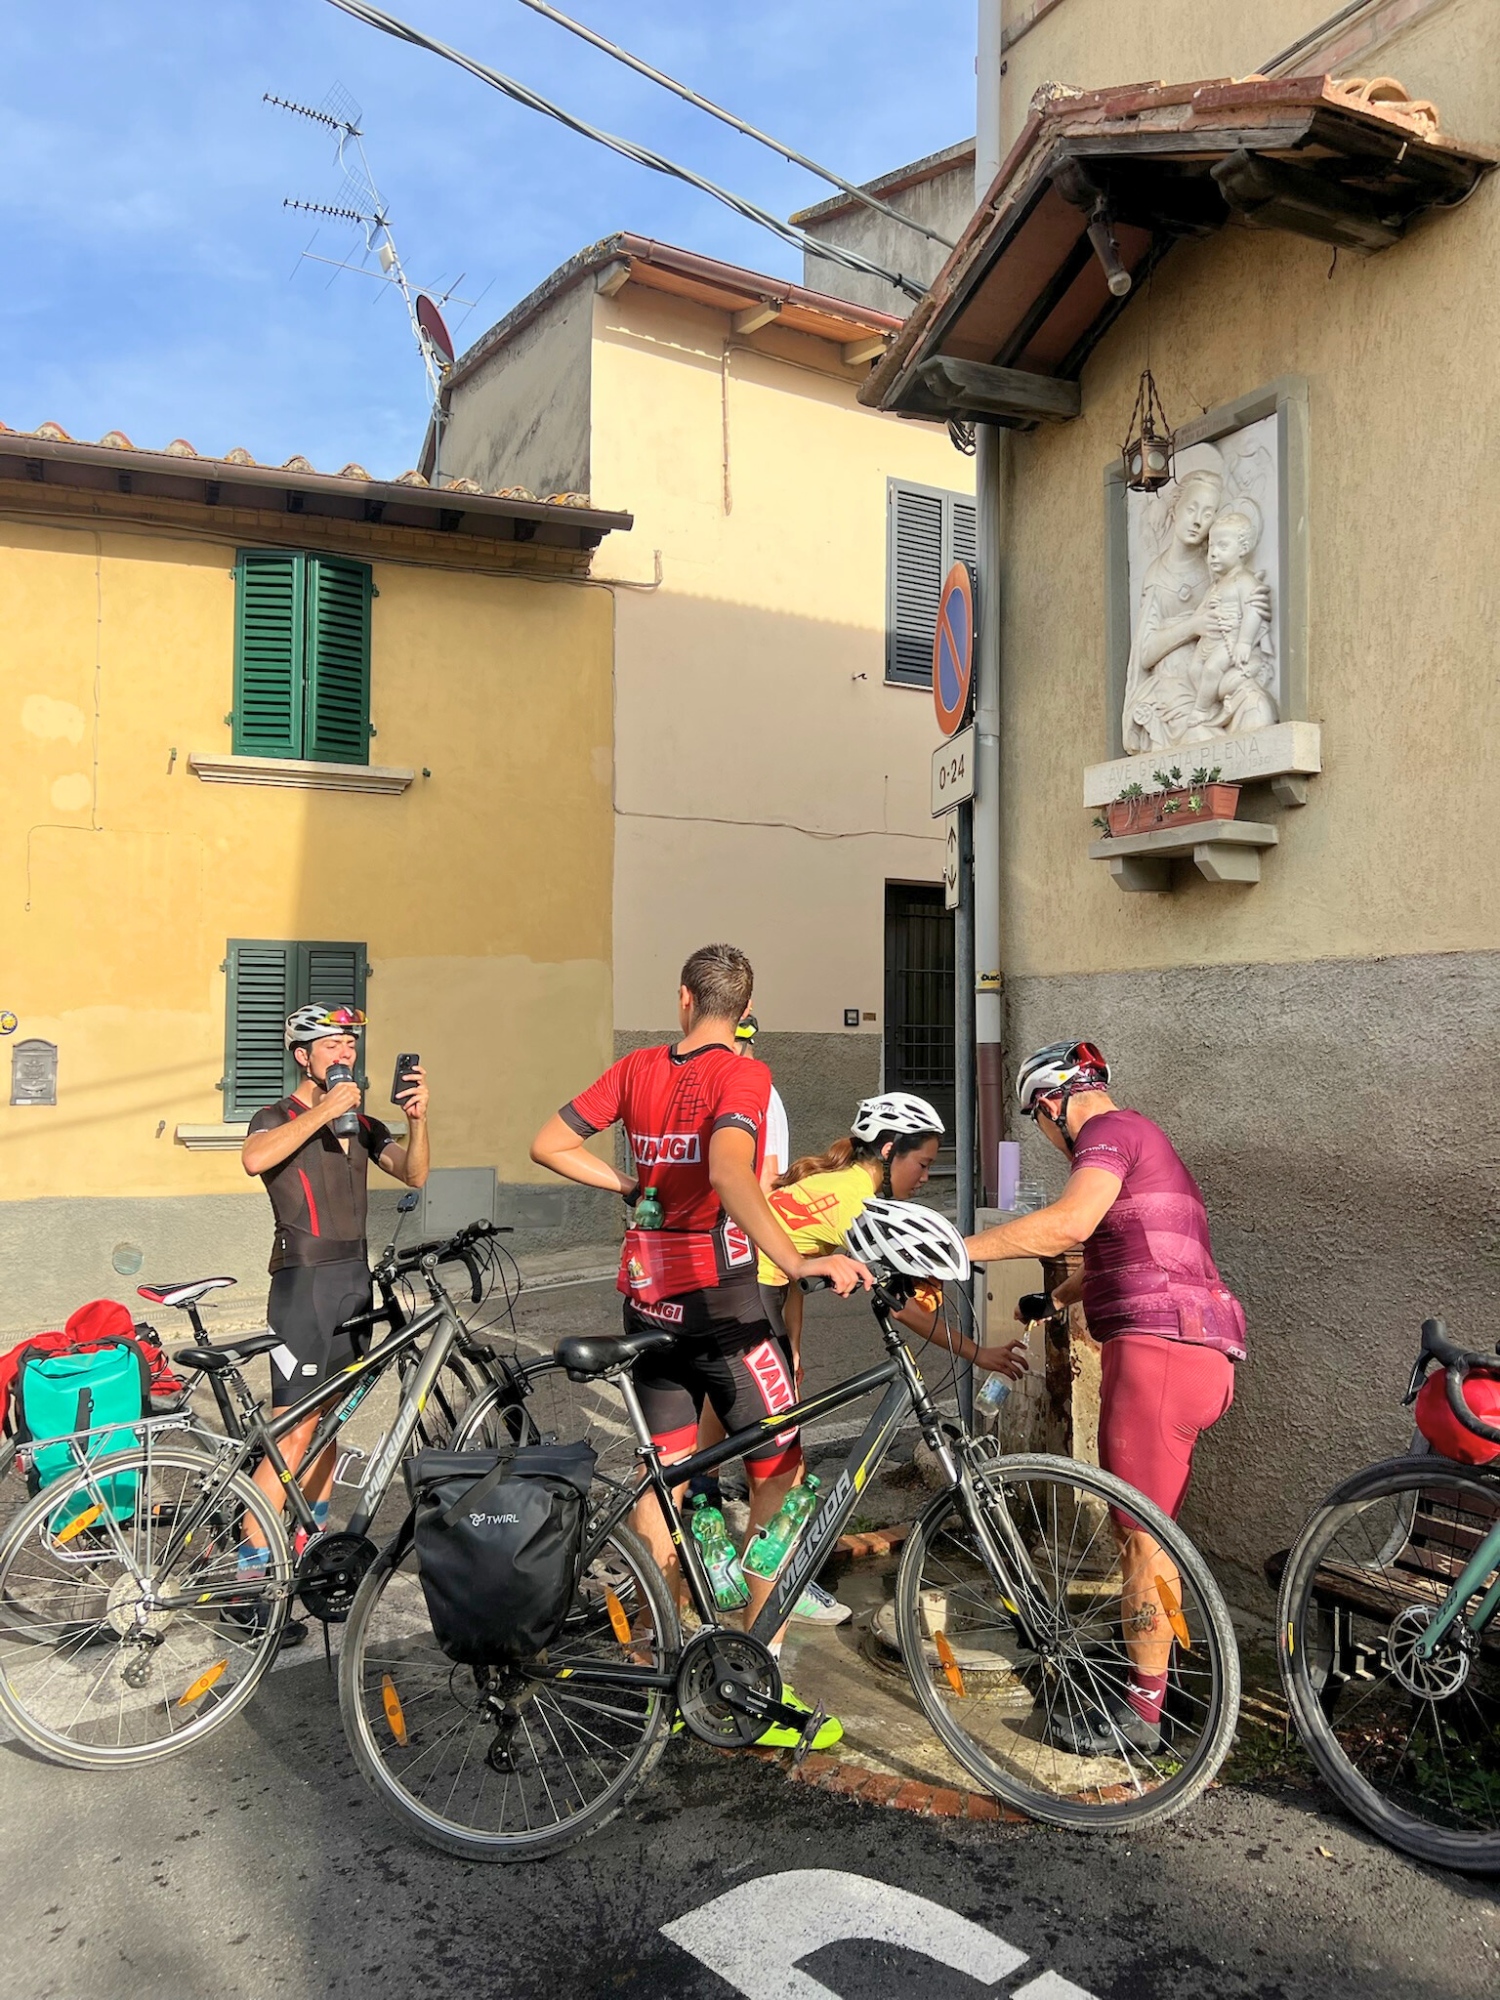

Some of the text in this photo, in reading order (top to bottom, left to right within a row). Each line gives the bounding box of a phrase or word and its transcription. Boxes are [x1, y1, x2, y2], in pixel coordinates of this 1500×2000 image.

[1108, 764, 1132, 784] AVE
[1199, 736, 1260, 764] PLENA
[364, 1397, 416, 1509] MERIDA
[486, 1513, 520, 1525] TWIRL
[777, 1468, 851, 1605] MERIDA
